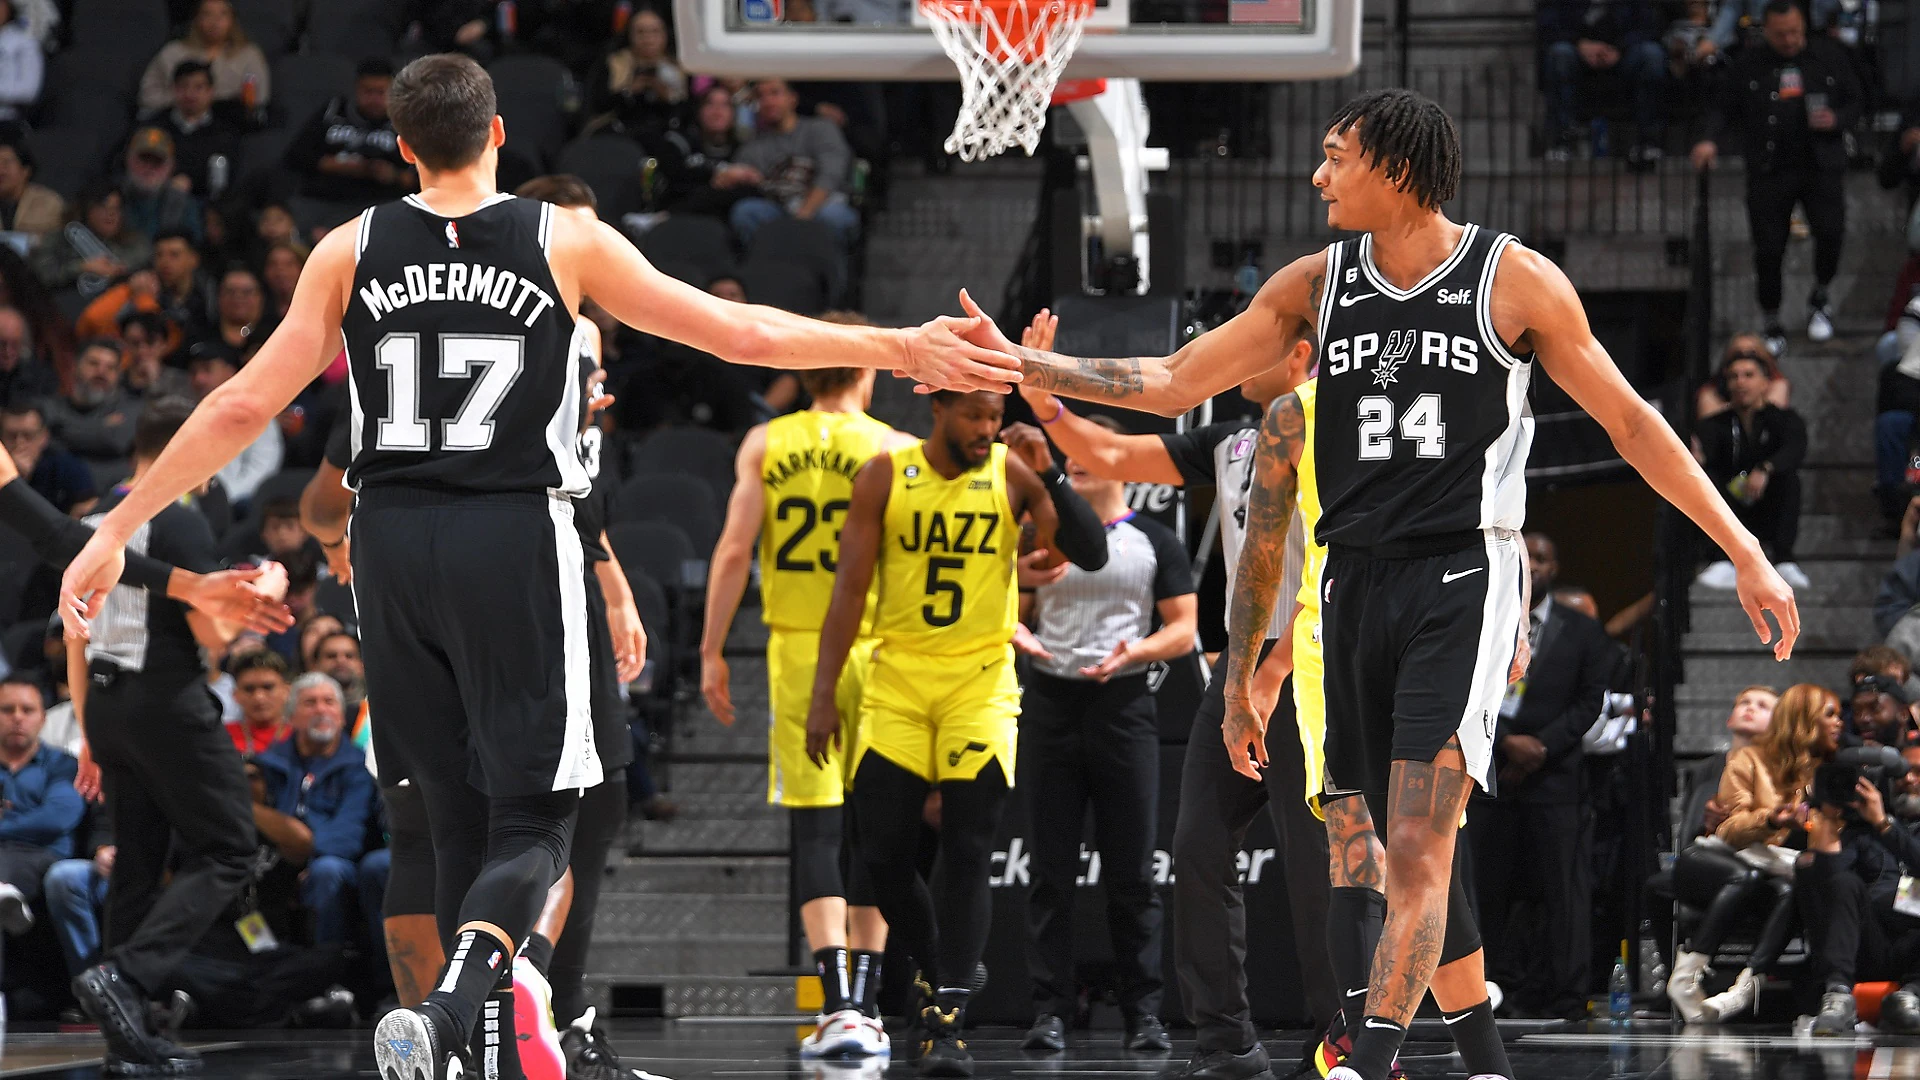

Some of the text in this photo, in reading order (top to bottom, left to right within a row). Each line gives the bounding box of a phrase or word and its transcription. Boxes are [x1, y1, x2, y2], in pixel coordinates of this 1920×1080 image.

[359, 262, 555, 328] McDERMOTT
[1345, 267, 1358, 284] 6
[1436, 288, 1472, 305] Self.
[375, 332, 526, 451] 17
[576, 425, 604, 480] 3
[1357, 393, 1446, 461] 24
[900, 511, 1000, 554] JAZZ
[922, 556, 965, 627] 5
